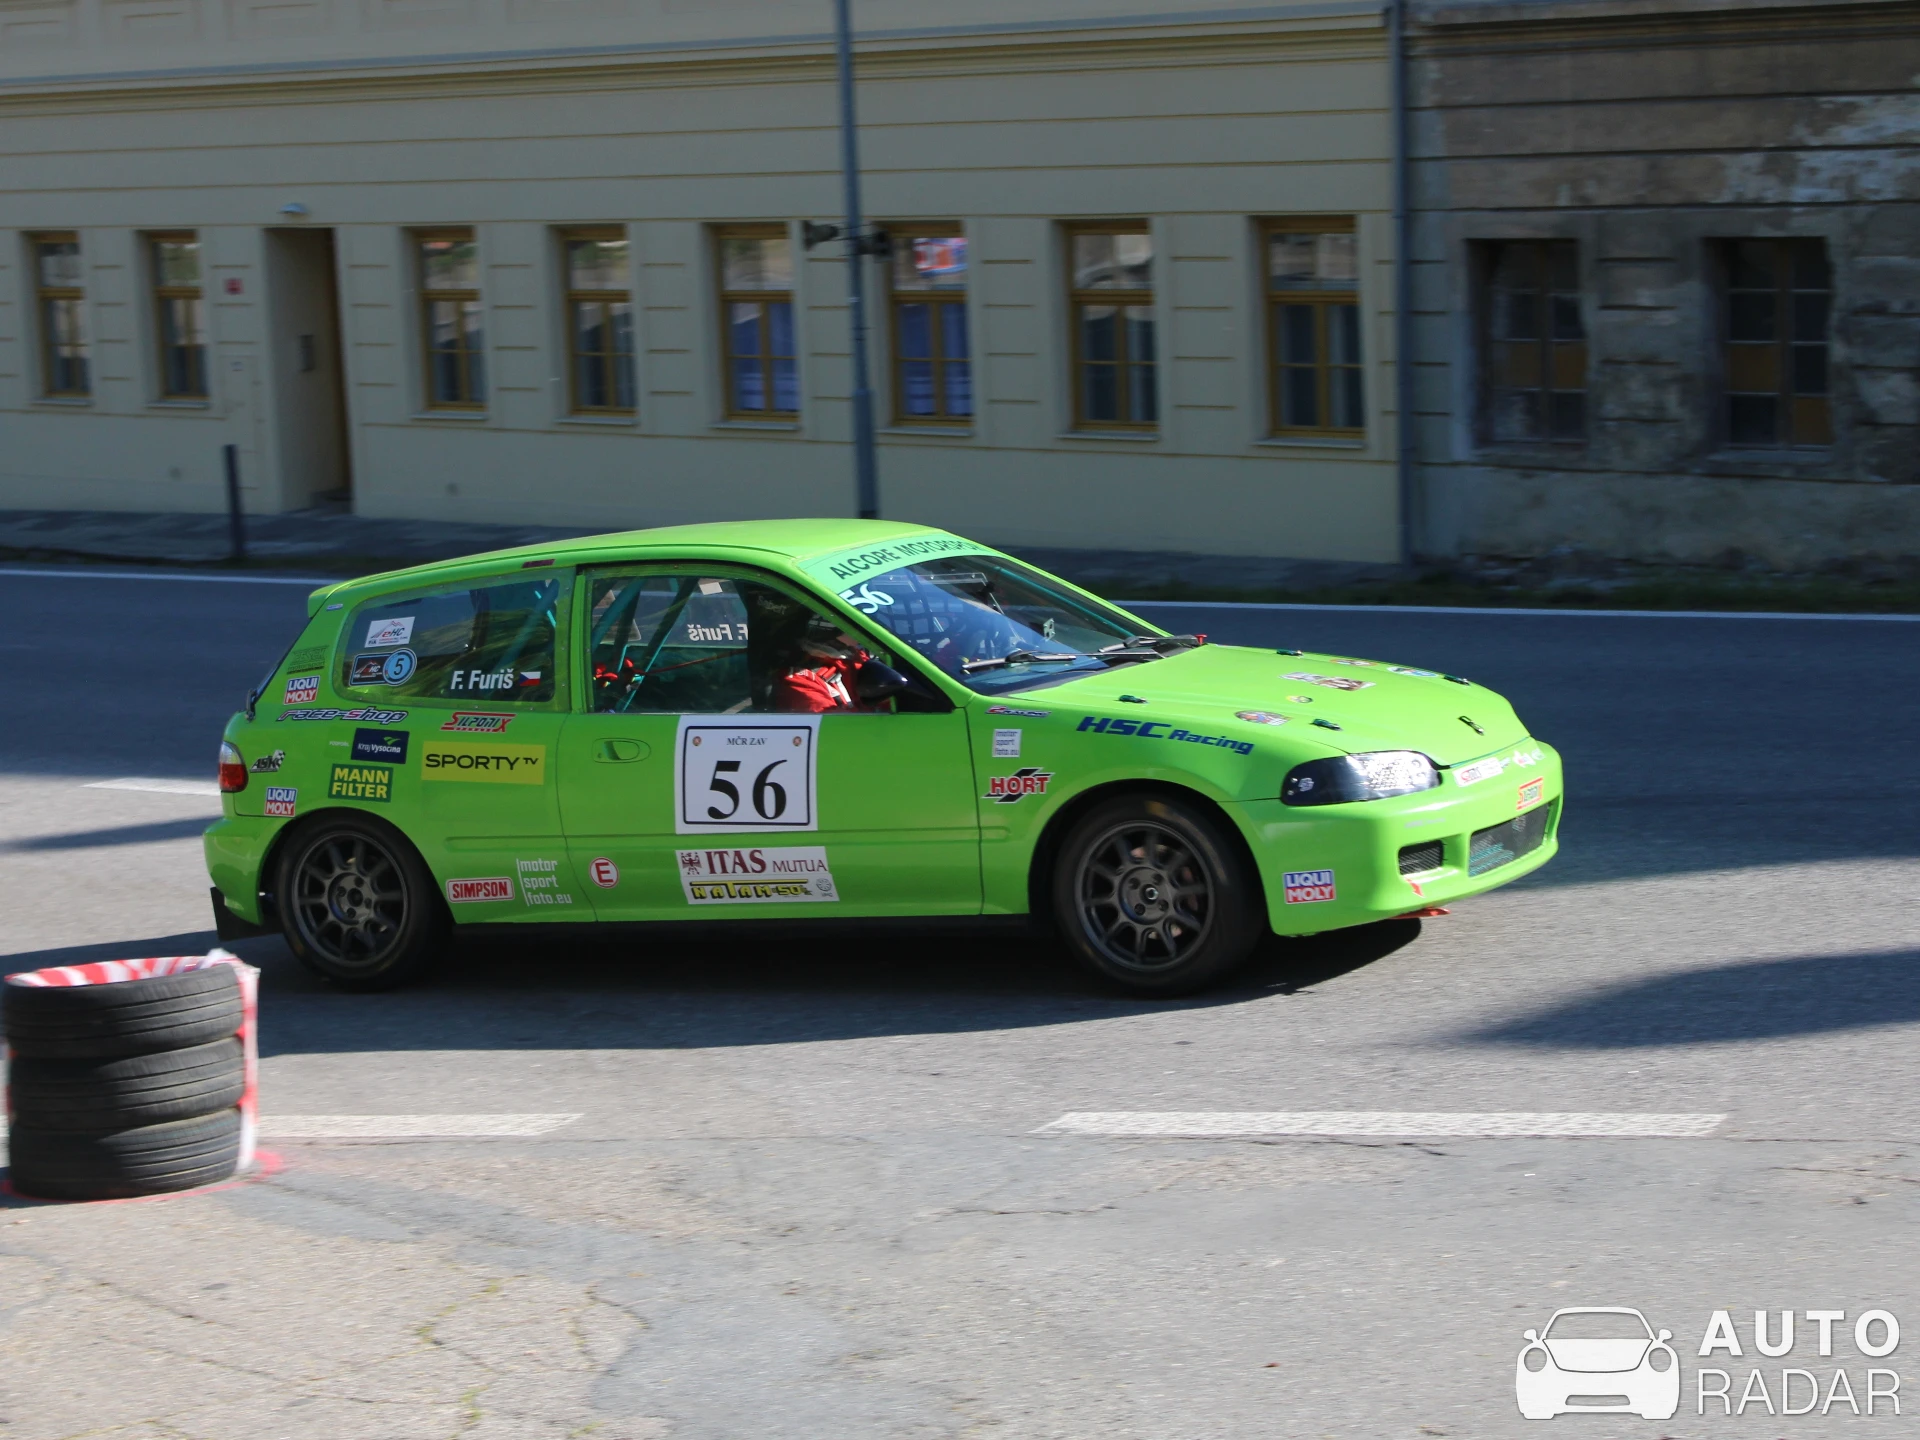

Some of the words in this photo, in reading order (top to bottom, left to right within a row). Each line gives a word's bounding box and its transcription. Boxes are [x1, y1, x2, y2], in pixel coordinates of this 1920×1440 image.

[829, 549, 902, 580] ALCORE
[838, 583, 894, 614] 56
[393, 658, 405, 676] 5
[288, 677, 318, 691] LIQUI
[450, 670, 464, 690] F.
[468, 668, 515, 690] Furiš
[285, 689, 317, 703] MOLY
[276, 706, 408, 725] race-shop
[726, 736, 748, 746] MČR
[749, 737, 768, 746] ZAV
[1076, 716, 1172, 739] HSC
[1168, 729, 1254, 755] Racing
[358, 743, 370, 752] Kraj
[425, 753, 519, 771] SPORTY
[523, 757, 539, 765] TV
[334, 767, 389, 783] MANN
[331, 782, 387, 799] FILTER
[707, 759, 788, 820] 56
[990, 776, 1049, 795] HORT
[268, 788, 295, 802] LIQUI
[266, 801, 294, 815] MOLY
[519, 858, 558, 872] motor
[705, 850, 767, 875] ITAS
[772, 859, 828, 873] MUTUA
[595, 861, 614, 884] E
[1286, 871, 1331, 888] LIQUI
[452, 881, 509, 899] SIMPSON
[524, 875, 559, 890] sport
[528, 892, 573, 905] foto.eu
[1287, 886, 1332, 902] MOLY
